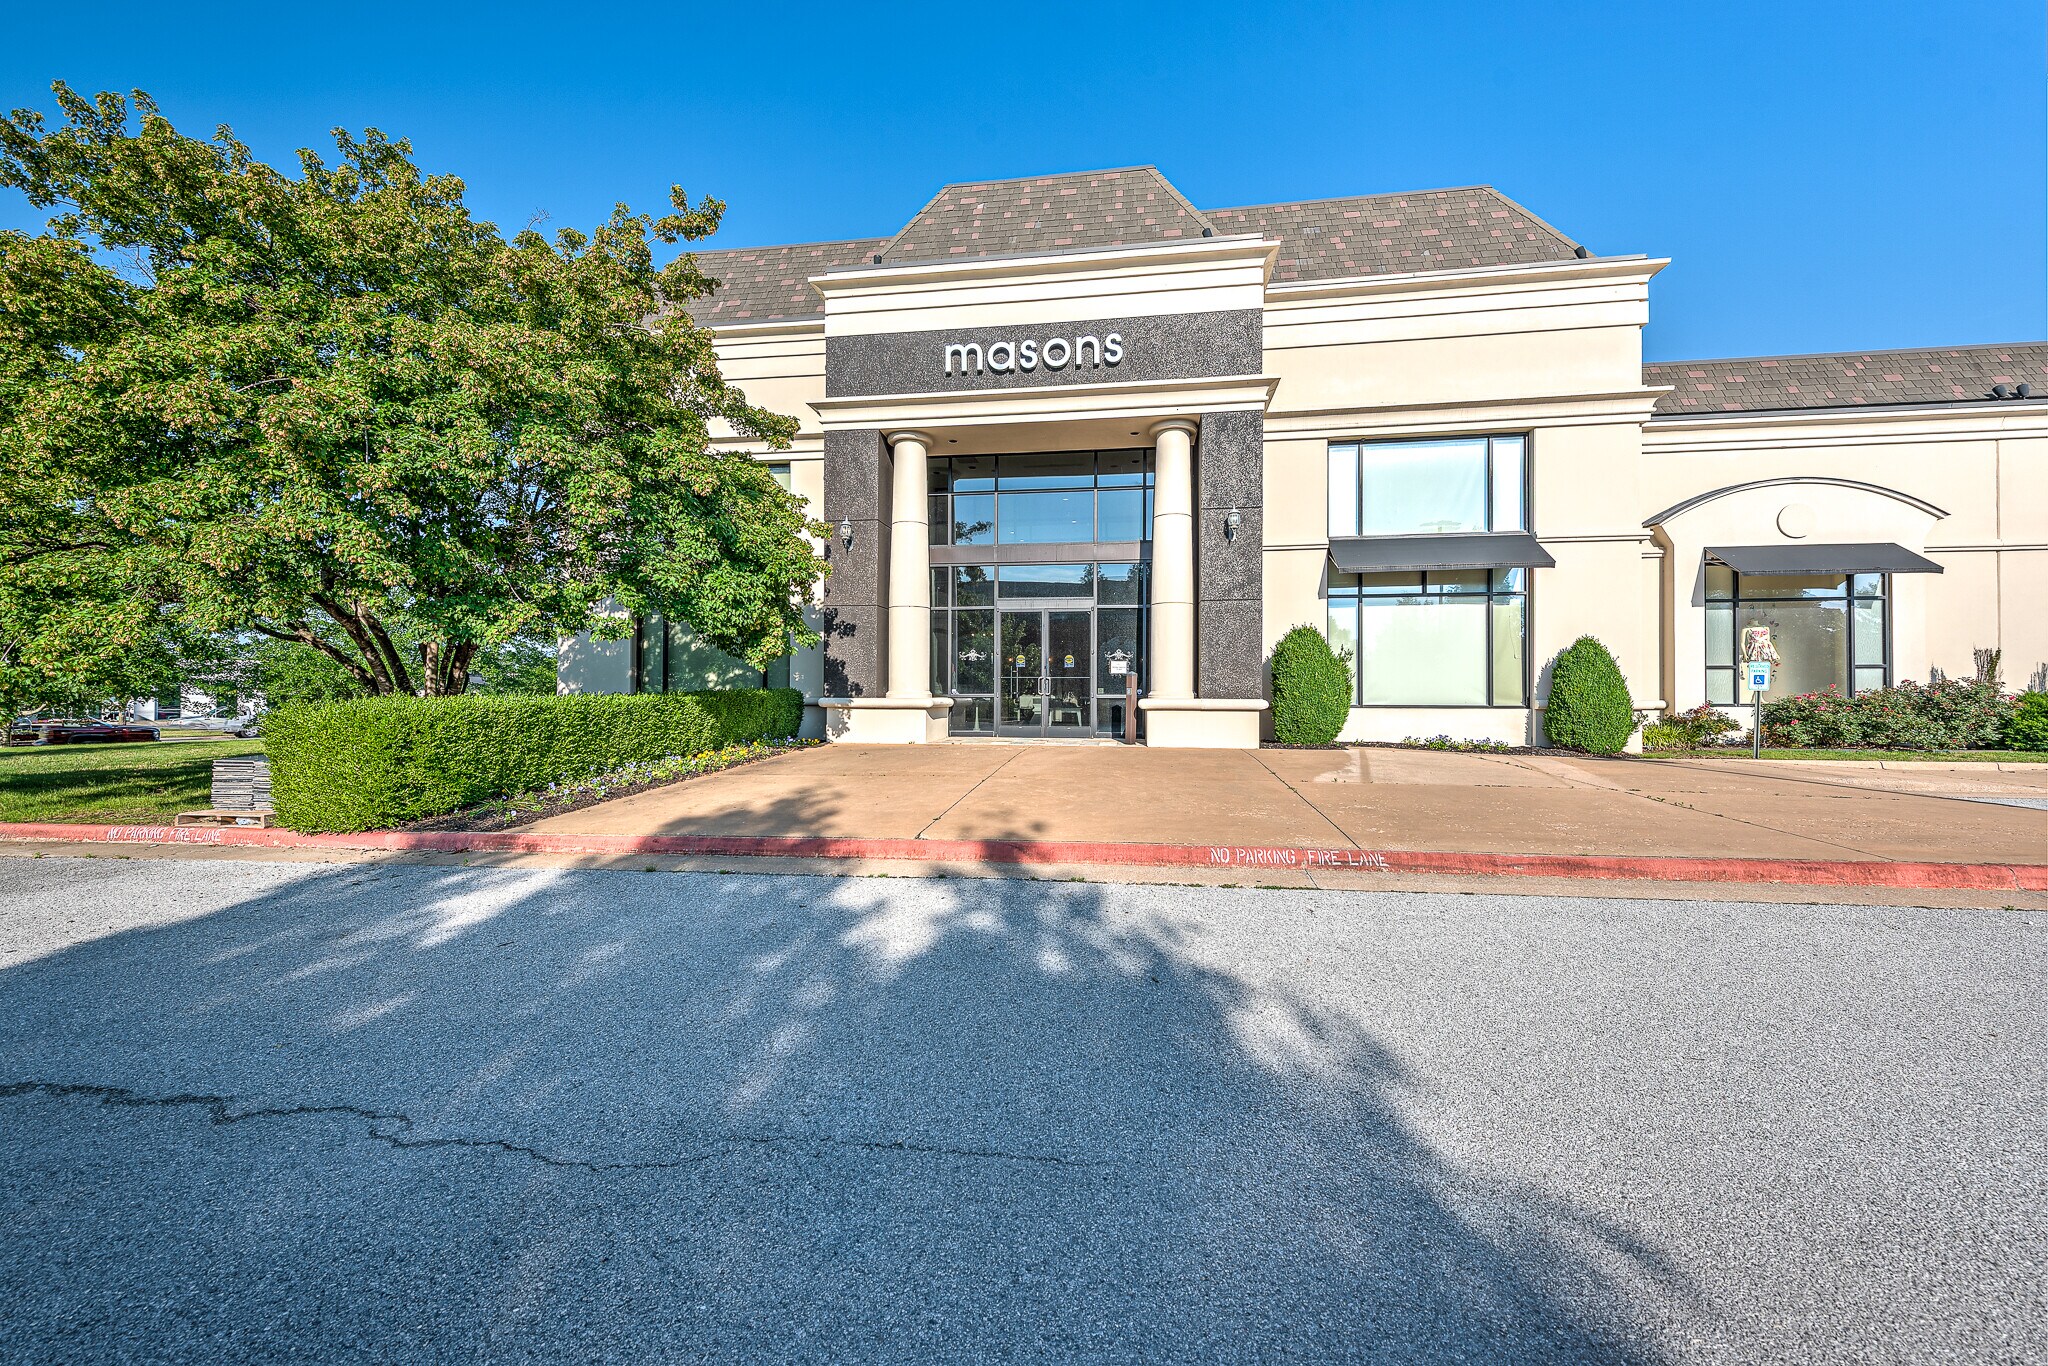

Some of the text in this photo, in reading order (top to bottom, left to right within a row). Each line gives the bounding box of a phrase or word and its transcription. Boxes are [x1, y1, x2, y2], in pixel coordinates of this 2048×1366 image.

[945, 333, 1123, 376] masons
[107, 827, 226, 842] NO PARKING FIRE LANE
[1210, 847, 1389, 867] NO PARKING FIRE LANE
